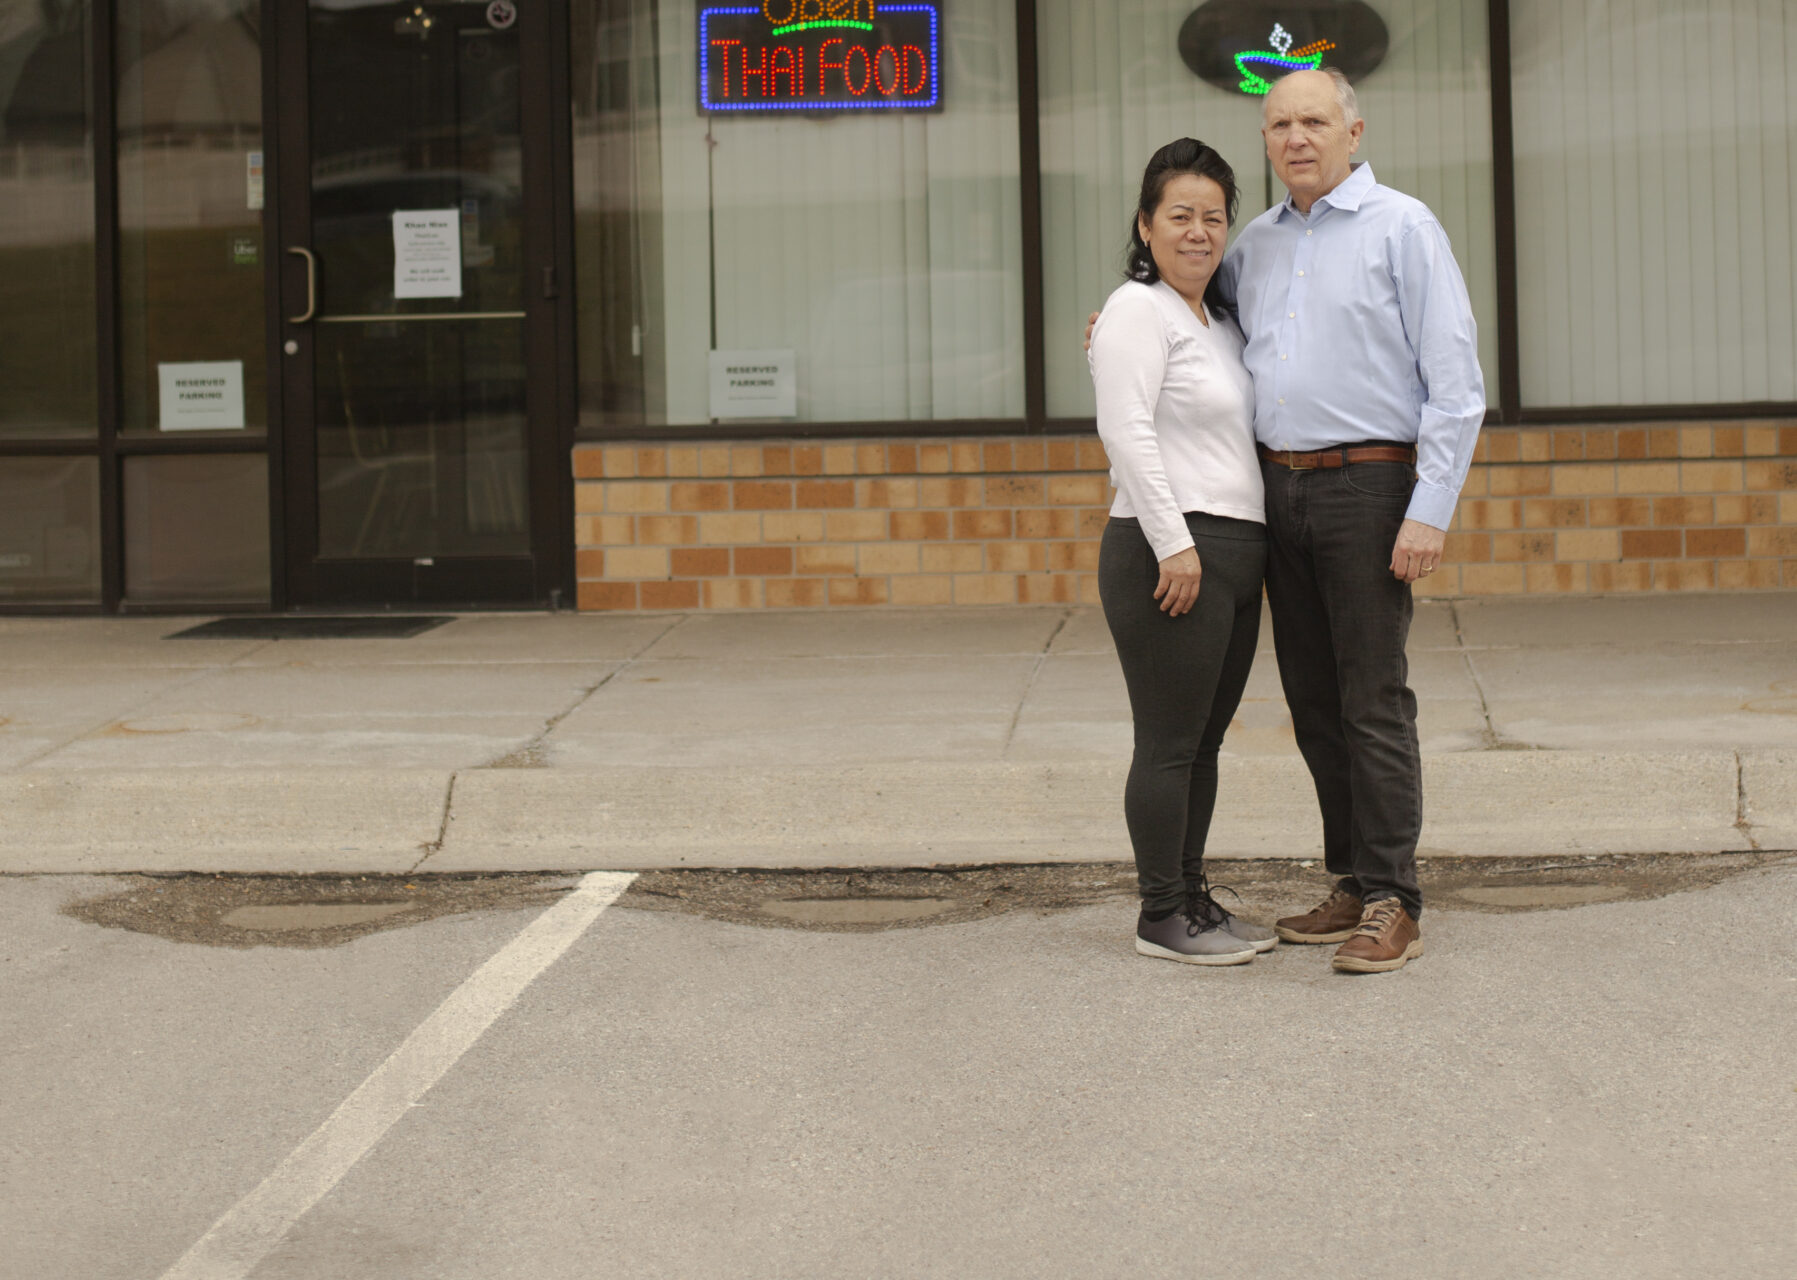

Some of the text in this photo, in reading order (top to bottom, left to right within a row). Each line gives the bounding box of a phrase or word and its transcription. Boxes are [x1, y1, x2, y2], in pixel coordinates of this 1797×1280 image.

[711, 38, 926, 97] THAI FOOD
[726, 366, 778, 375] RESERVED
[175, 378, 226, 387] RESERVED
[730, 379, 775, 387] PARKING
[179, 392, 223, 401] PARKING
